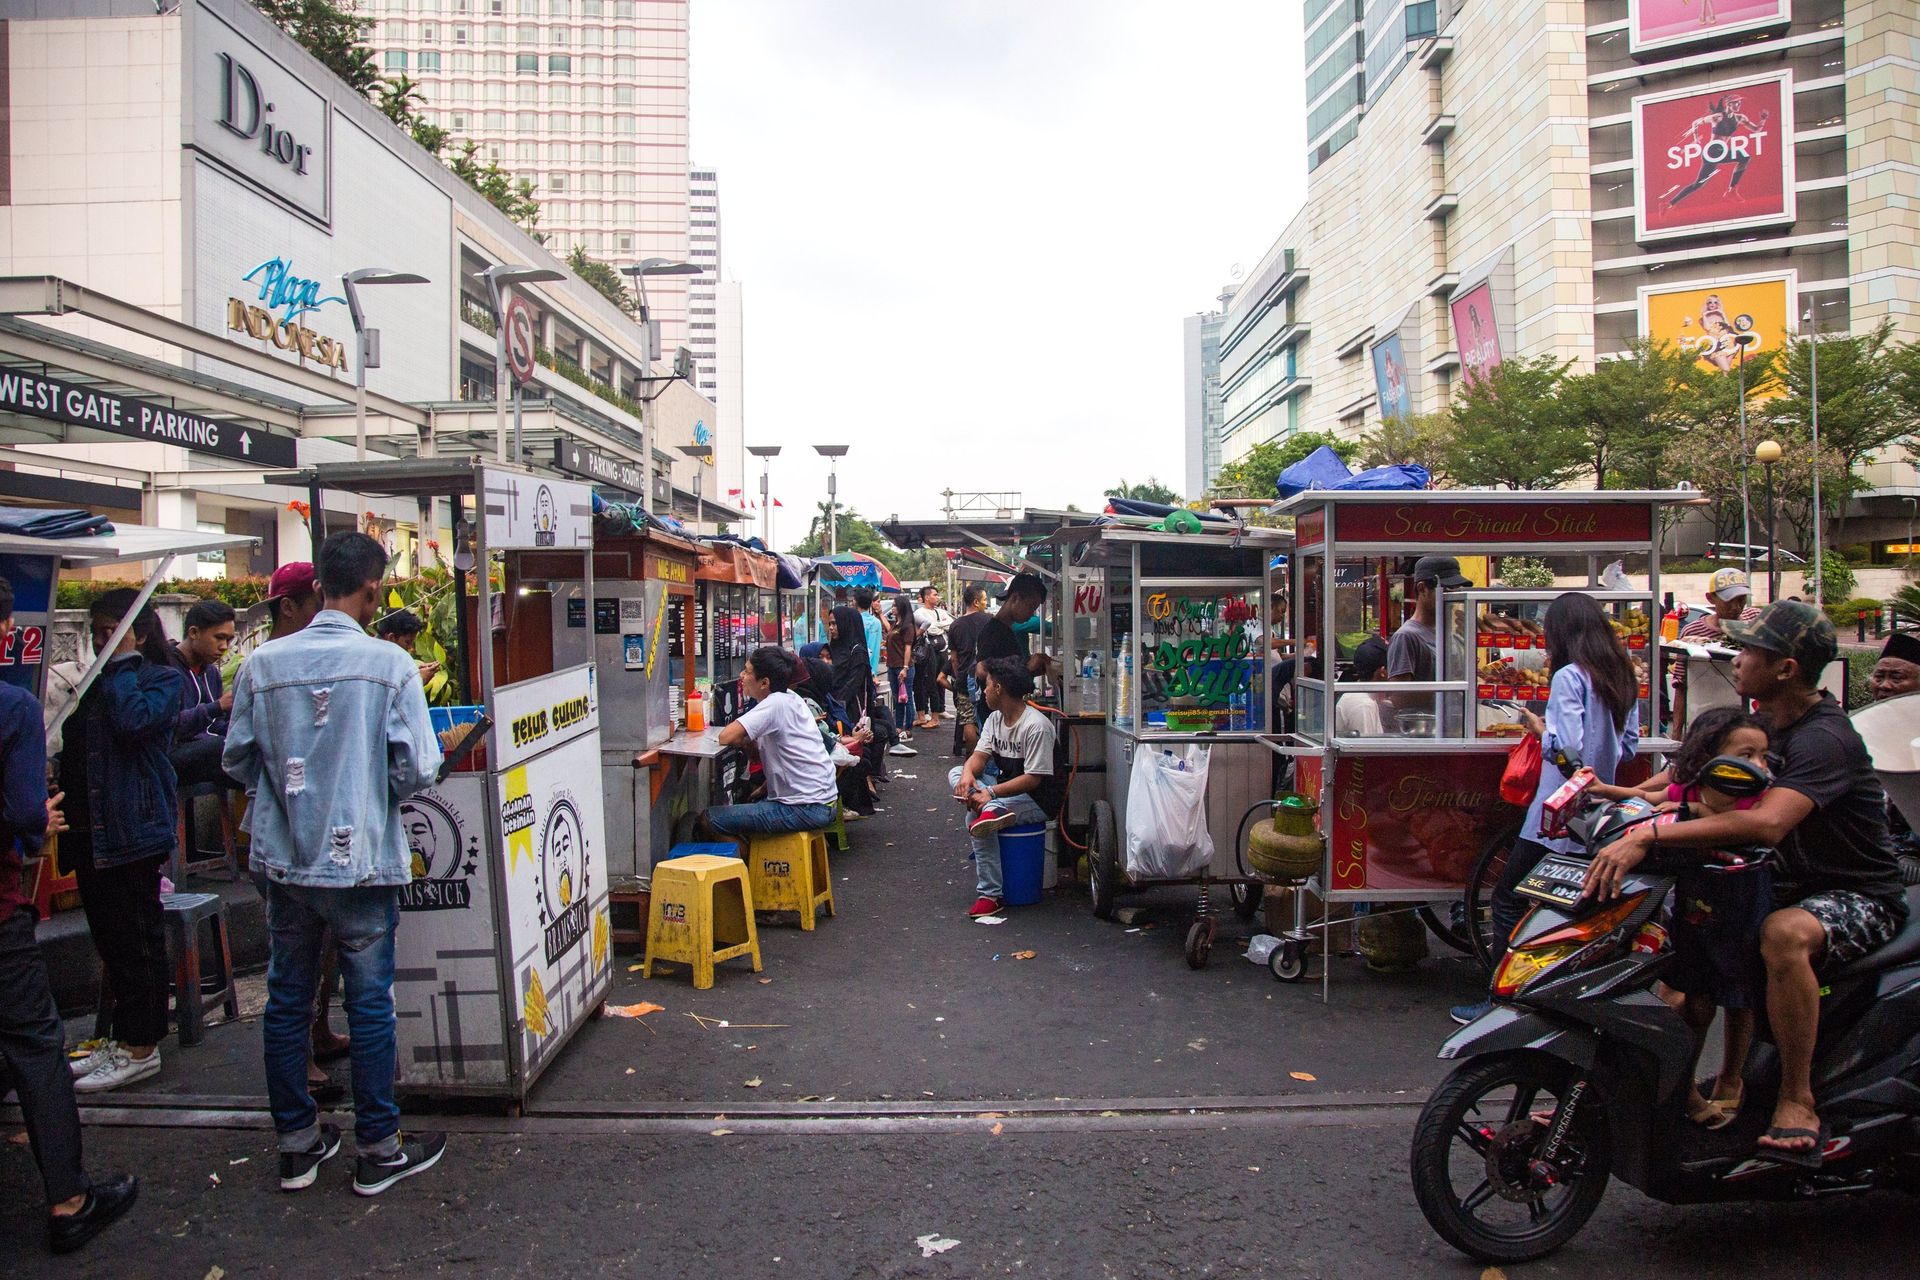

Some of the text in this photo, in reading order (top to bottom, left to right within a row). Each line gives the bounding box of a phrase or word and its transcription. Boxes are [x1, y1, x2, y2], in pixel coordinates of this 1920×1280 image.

[219, 52, 312, 176] Dior
[1667, 131, 1768, 169] SPORT
[242, 256, 347, 327] Plaza
[227, 297, 348, 372] INDONESIA
[1464, 338, 1496, 367] BEAUTY
[0, 373, 61, 413] WEST
[66, 390, 121, 427] GATE
[141, 406, 220, 447] PARKING
[588, 452, 618, 480] PARKING
[622, 465, 640, 488] SOUTH
[1384, 506, 1597, 537] Sea Friend Stick
[1074, 585, 1104, 615] KU
[1337, 838, 1366, 889] Sea
